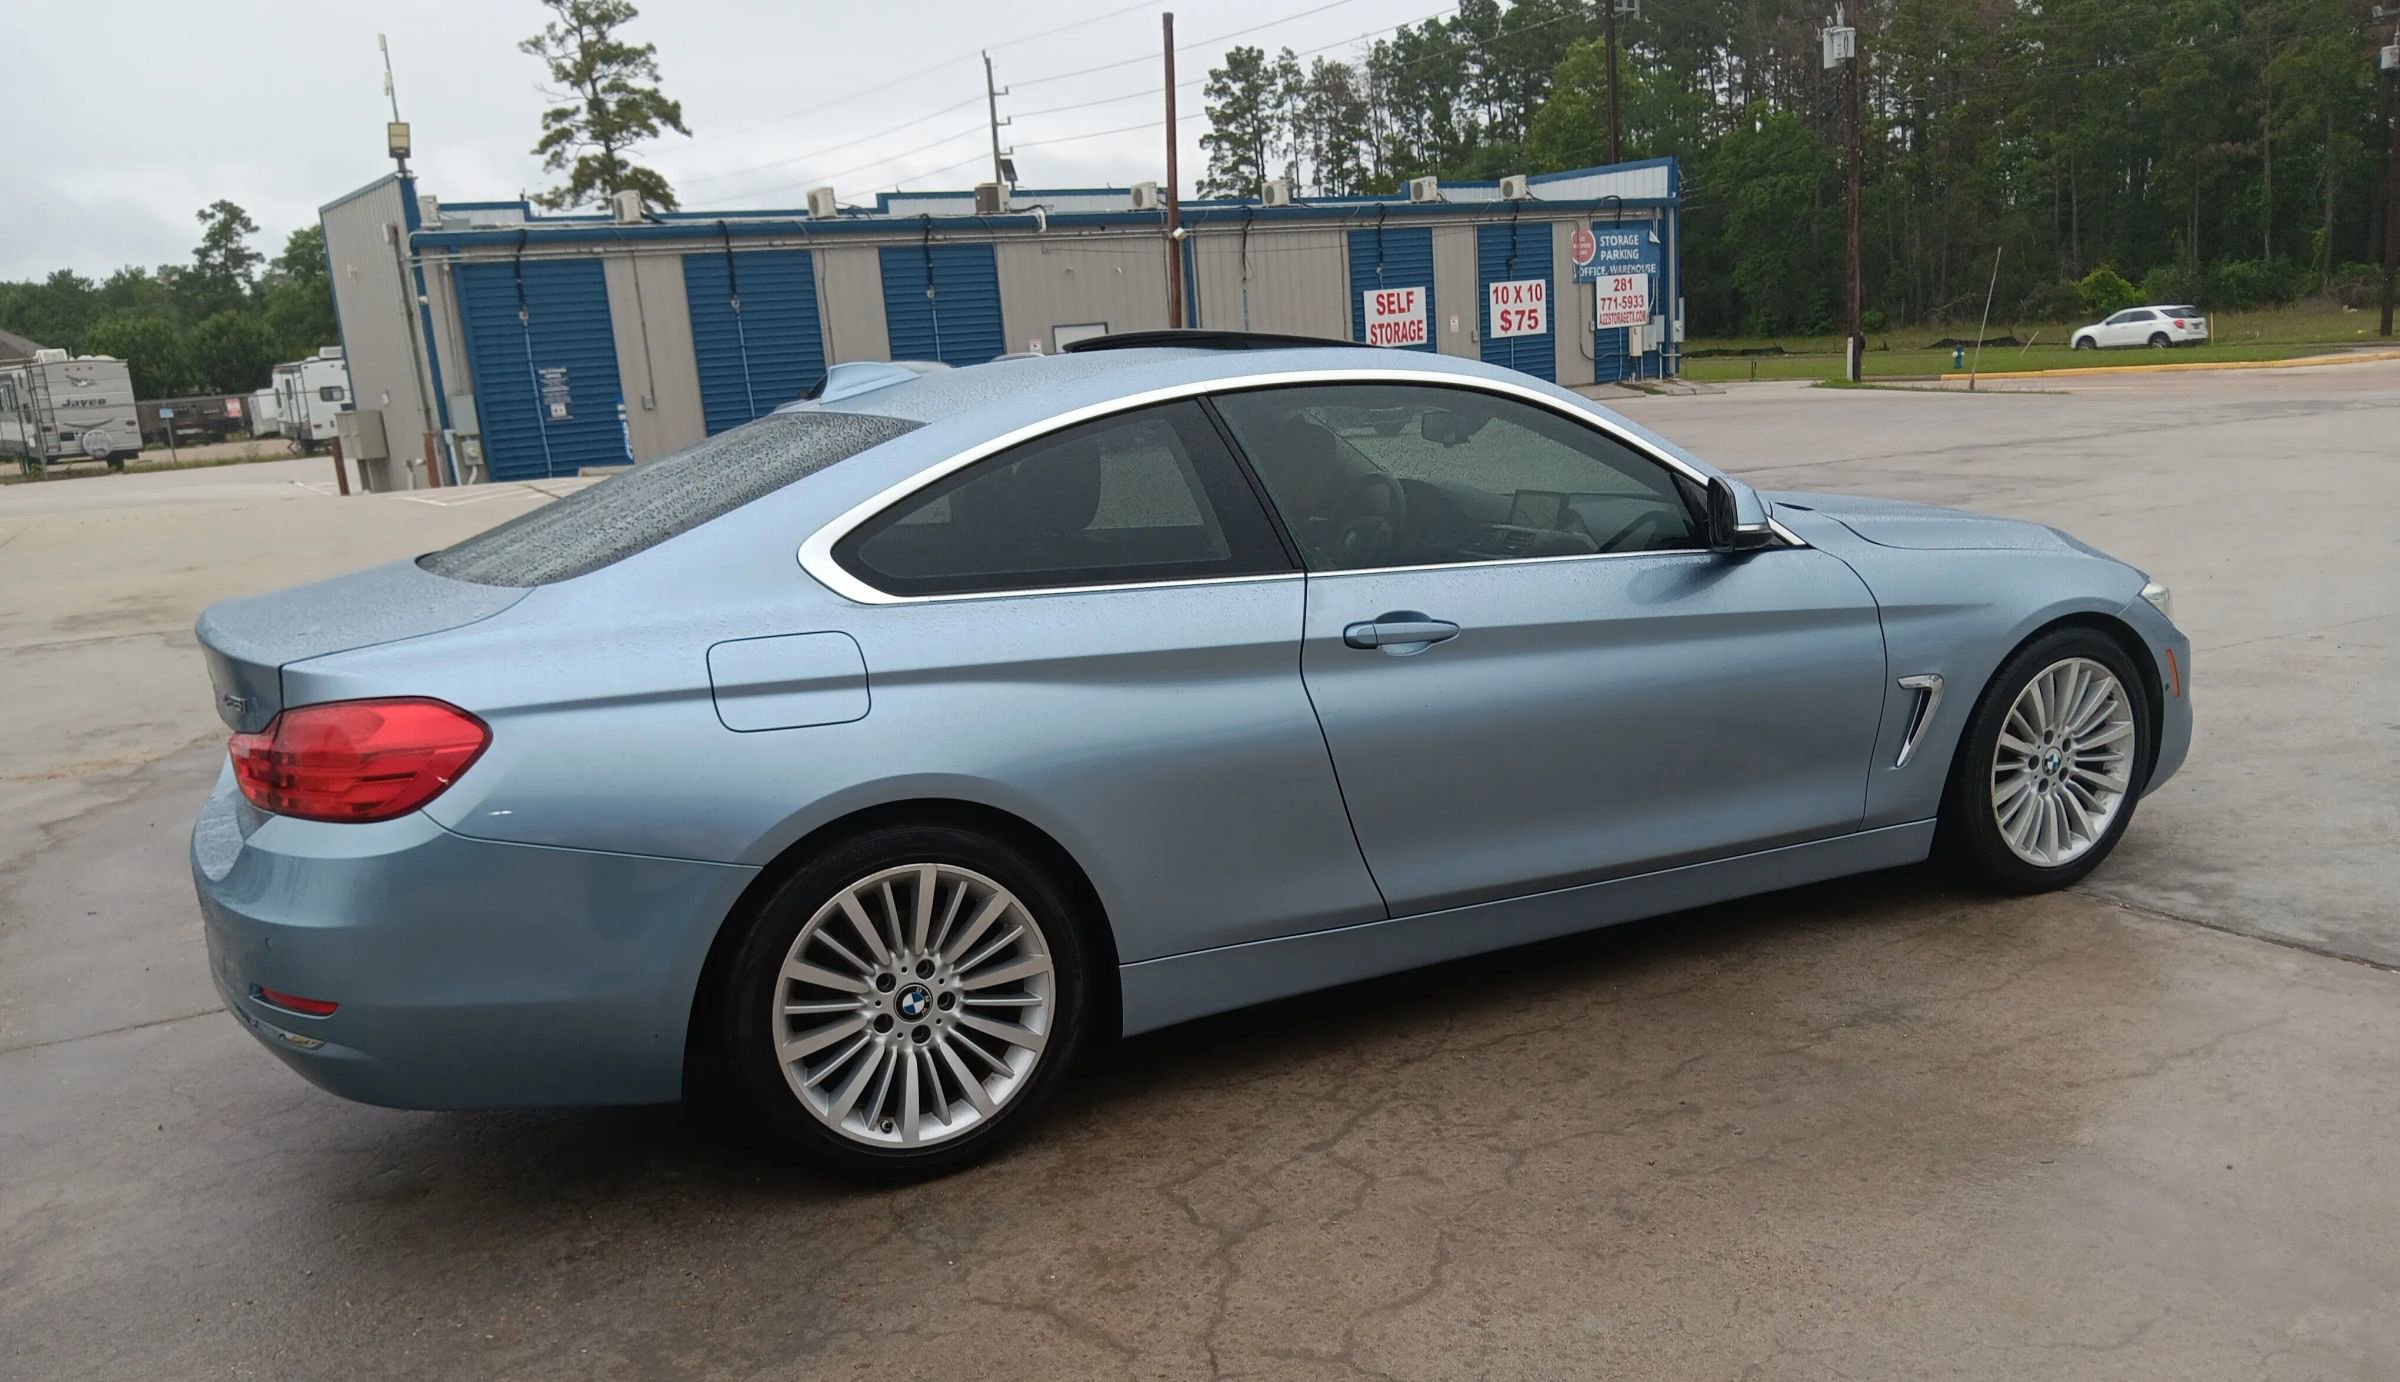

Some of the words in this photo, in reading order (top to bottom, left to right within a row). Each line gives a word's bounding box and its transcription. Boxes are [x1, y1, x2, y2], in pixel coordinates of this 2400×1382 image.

[1600, 234, 1639, 247] STORAGE
[1601, 248, 1639, 261] PARKING
[1609, 263, 1657, 274] WAREHOUSE
[1614, 277, 1632, 292] 281
[1493, 286, 1509, 305] 10
[1527, 283, 1542, 303] 10
[1376, 291, 1414, 316] SELF
[1600, 294, 1644, 310] 771-5933
[1500, 308, 1539, 334] $75
[1370, 319, 1424, 346] STORAGE
[61, 398, 106, 408] Jayco
